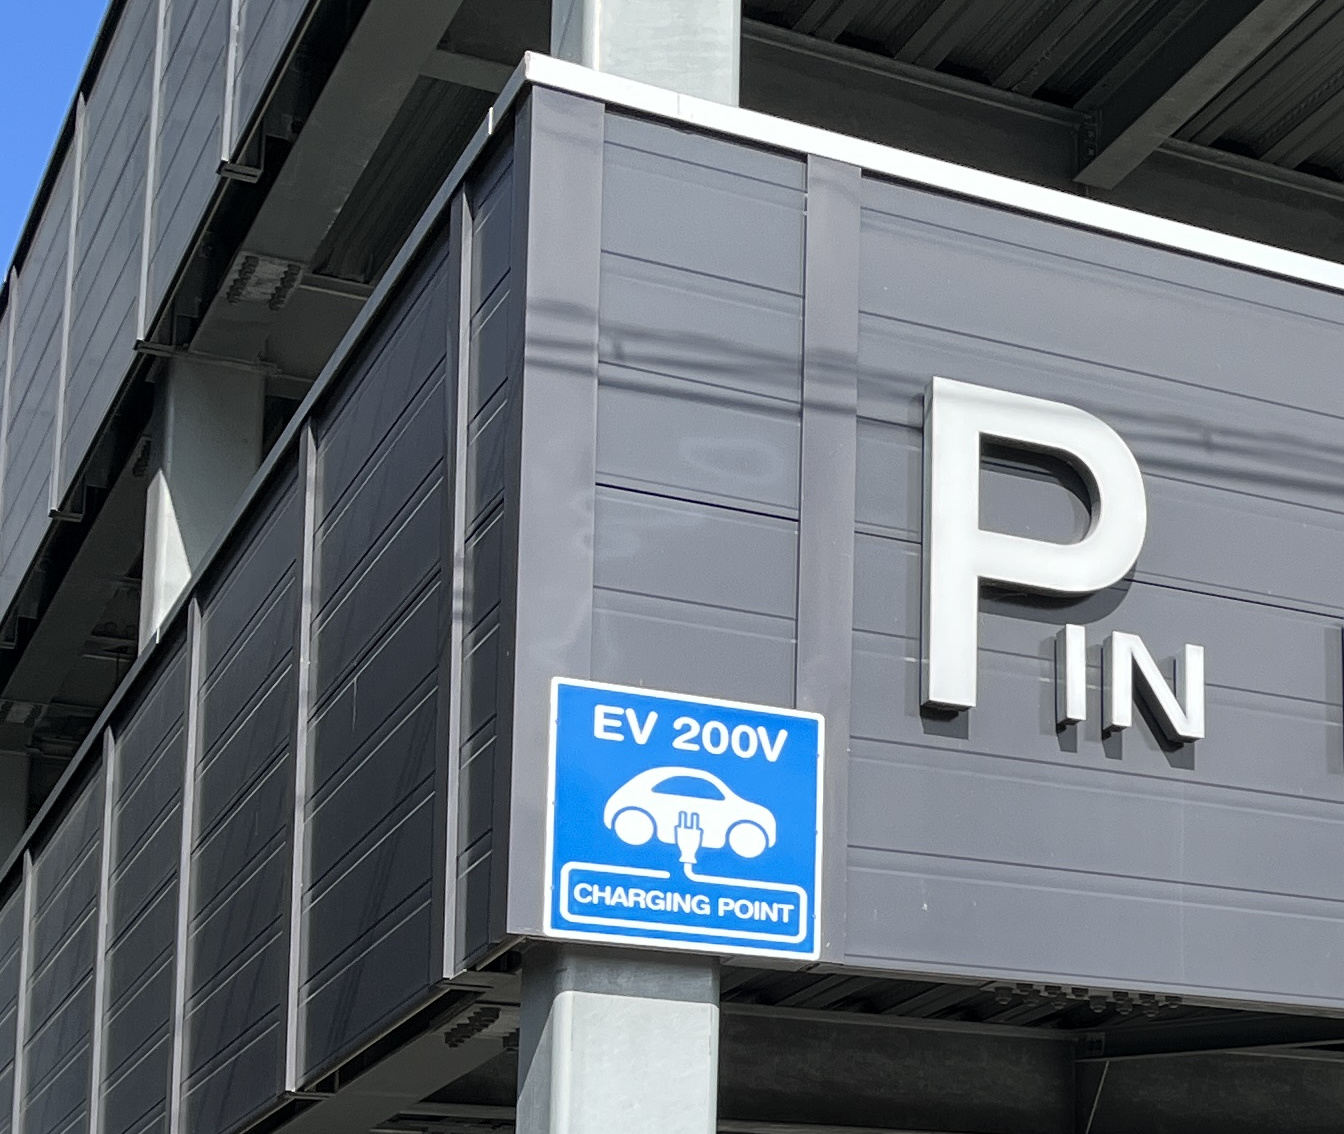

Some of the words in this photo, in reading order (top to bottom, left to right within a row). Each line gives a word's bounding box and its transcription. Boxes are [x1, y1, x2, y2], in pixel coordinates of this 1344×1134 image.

[593, 704, 658, 745] EV
[672, 716, 788, 763] 200V
[573, 883, 711, 915] CHARGING
[718, 898, 795, 923] POINT
